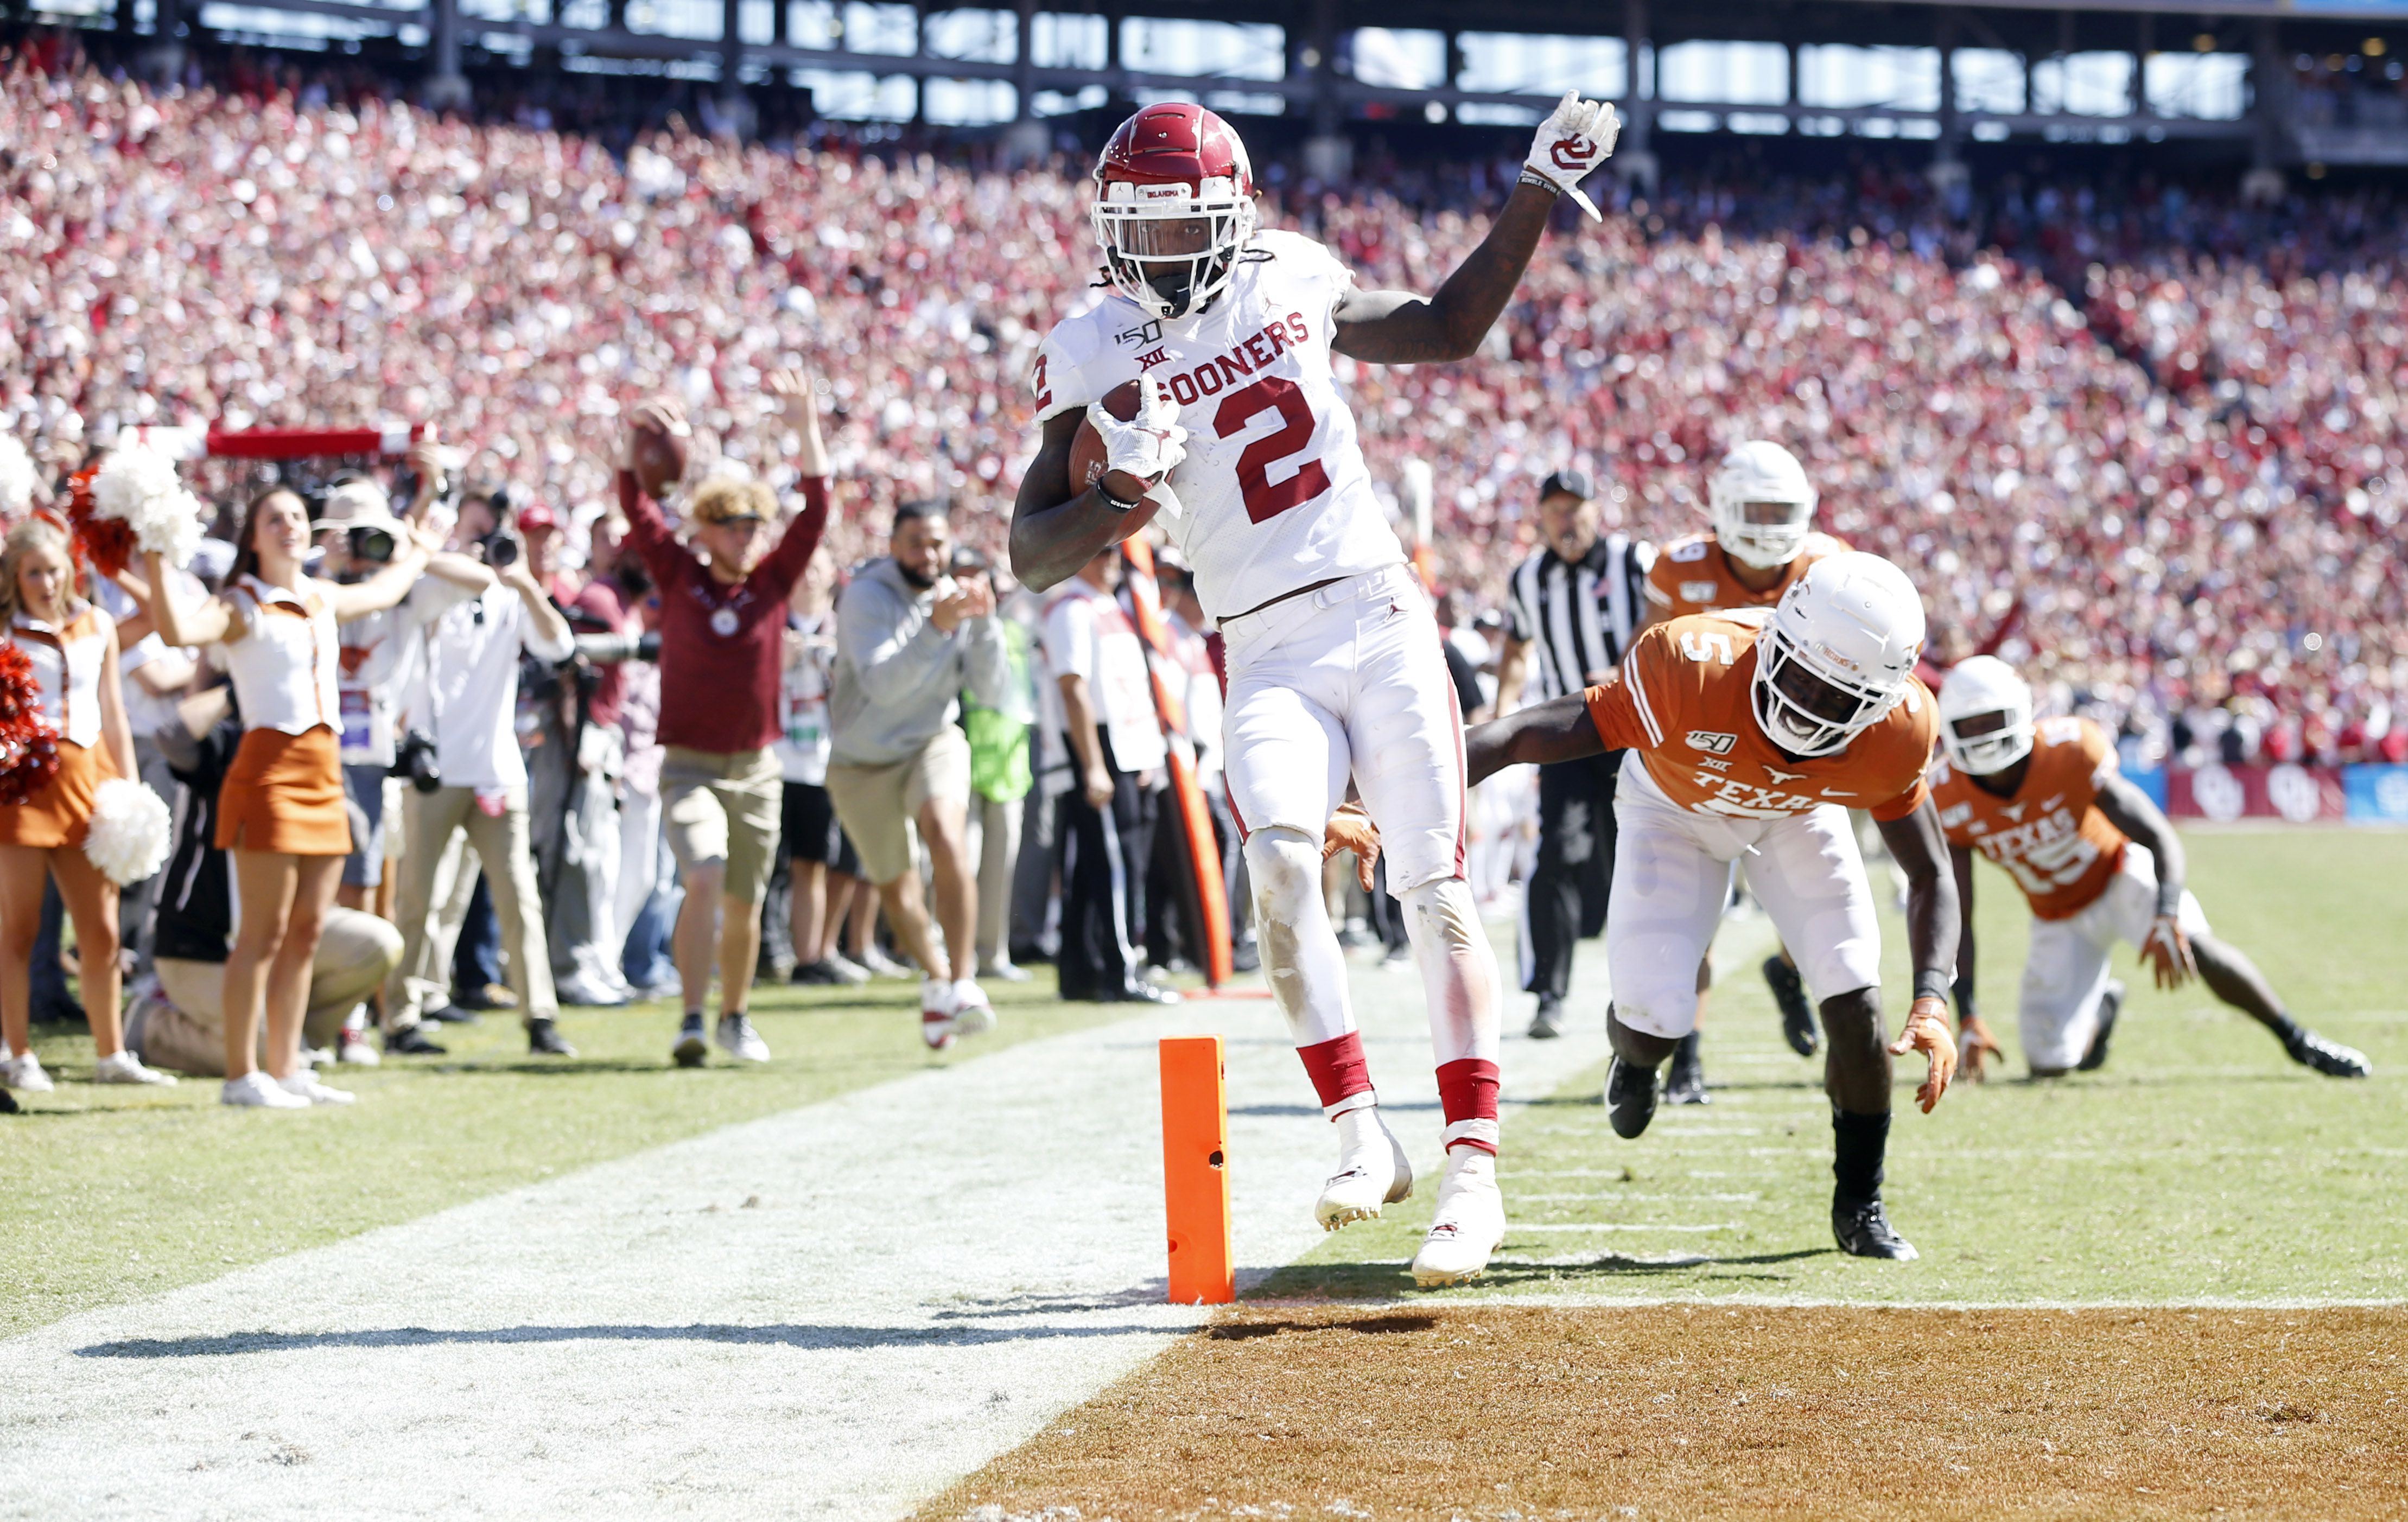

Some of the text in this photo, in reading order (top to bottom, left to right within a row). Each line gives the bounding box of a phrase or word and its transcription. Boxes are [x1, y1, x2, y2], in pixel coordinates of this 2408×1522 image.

[1146, 190, 1179, 199] OKLAHOMA
[1114, 319, 1164, 351] 150
[1213, 375, 1332, 525] 2
[1679, 631, 1734, 666] 5
[1688, 731, 1737, 754] 150
[1976, 807, 2077, 861] TEXAS
